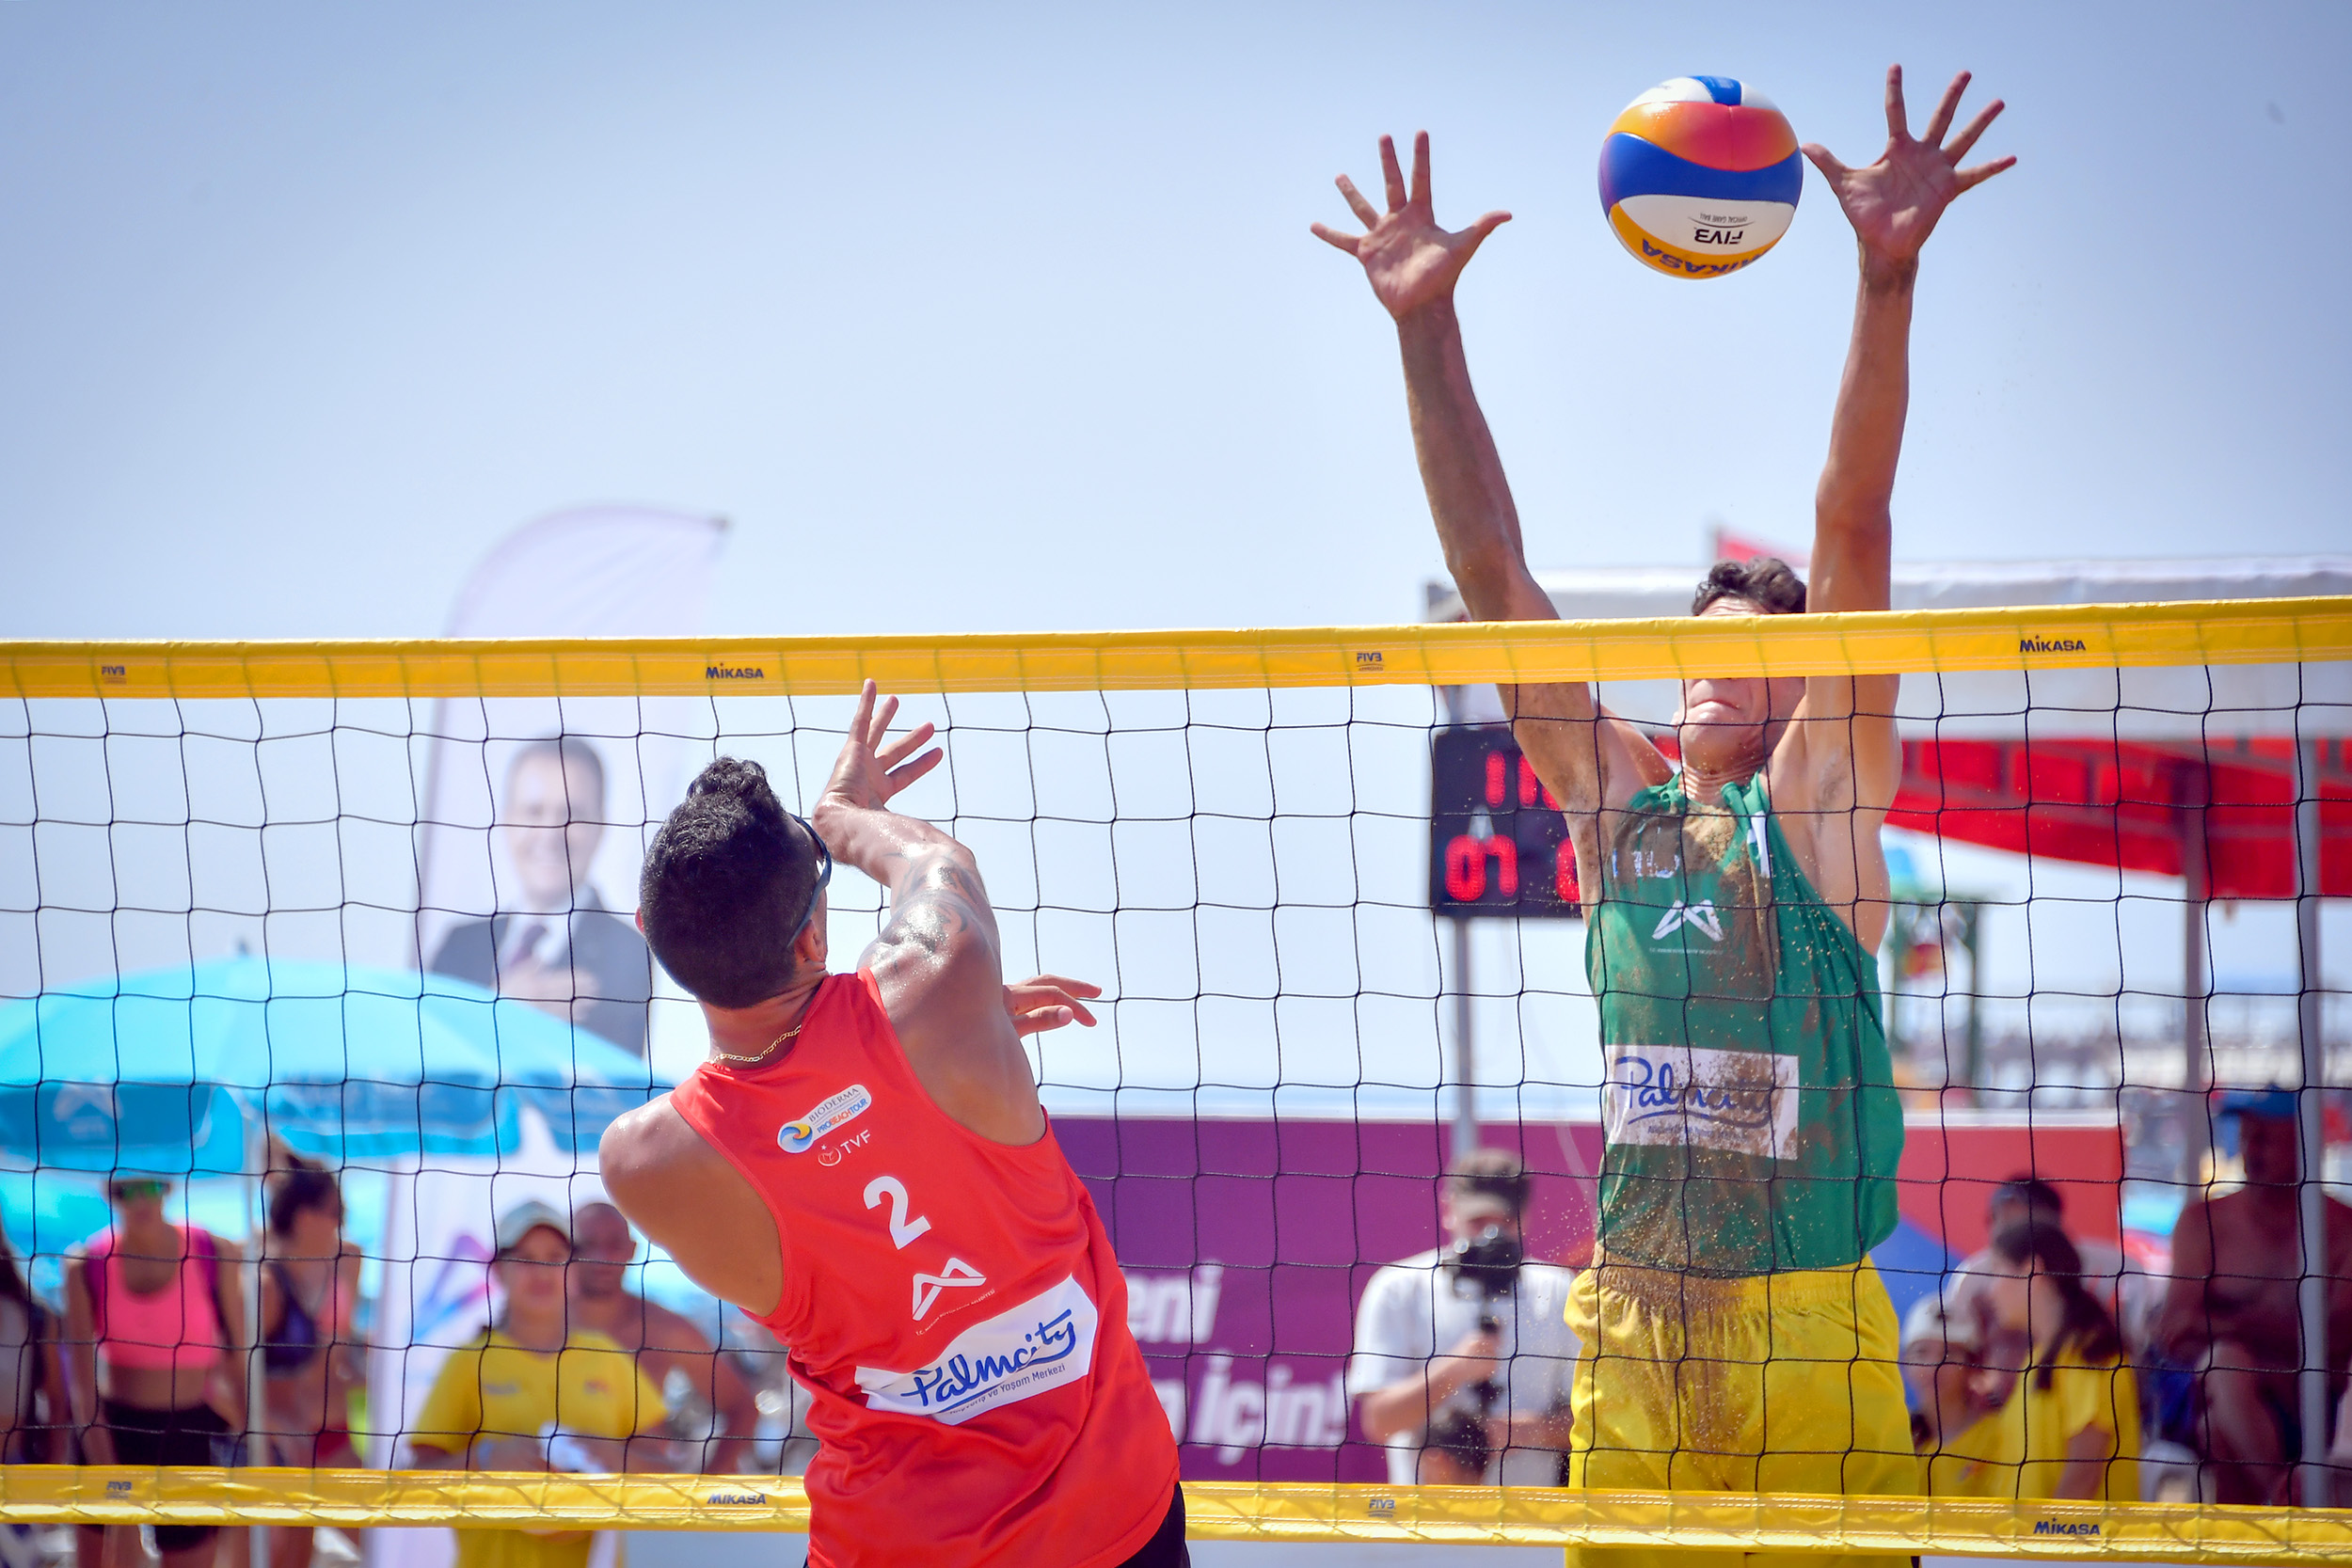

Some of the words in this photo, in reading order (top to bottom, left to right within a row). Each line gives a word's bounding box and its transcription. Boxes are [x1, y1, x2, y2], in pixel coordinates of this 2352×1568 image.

[809, 1087, 859, 1122] BIODERMA
[840, 1129, 871, 1154] TVF
[864, 1175, 931, 1250] 2
[1123, 1261, 1222, 1344] eni
[900, 1308, 1076, 1412] Palmcity
[988, 1387, 998, 1398] ve
[999, 1375, 1030, 1393] Yaşam
[1032, 1363, 1066, 1382] Merkezi
